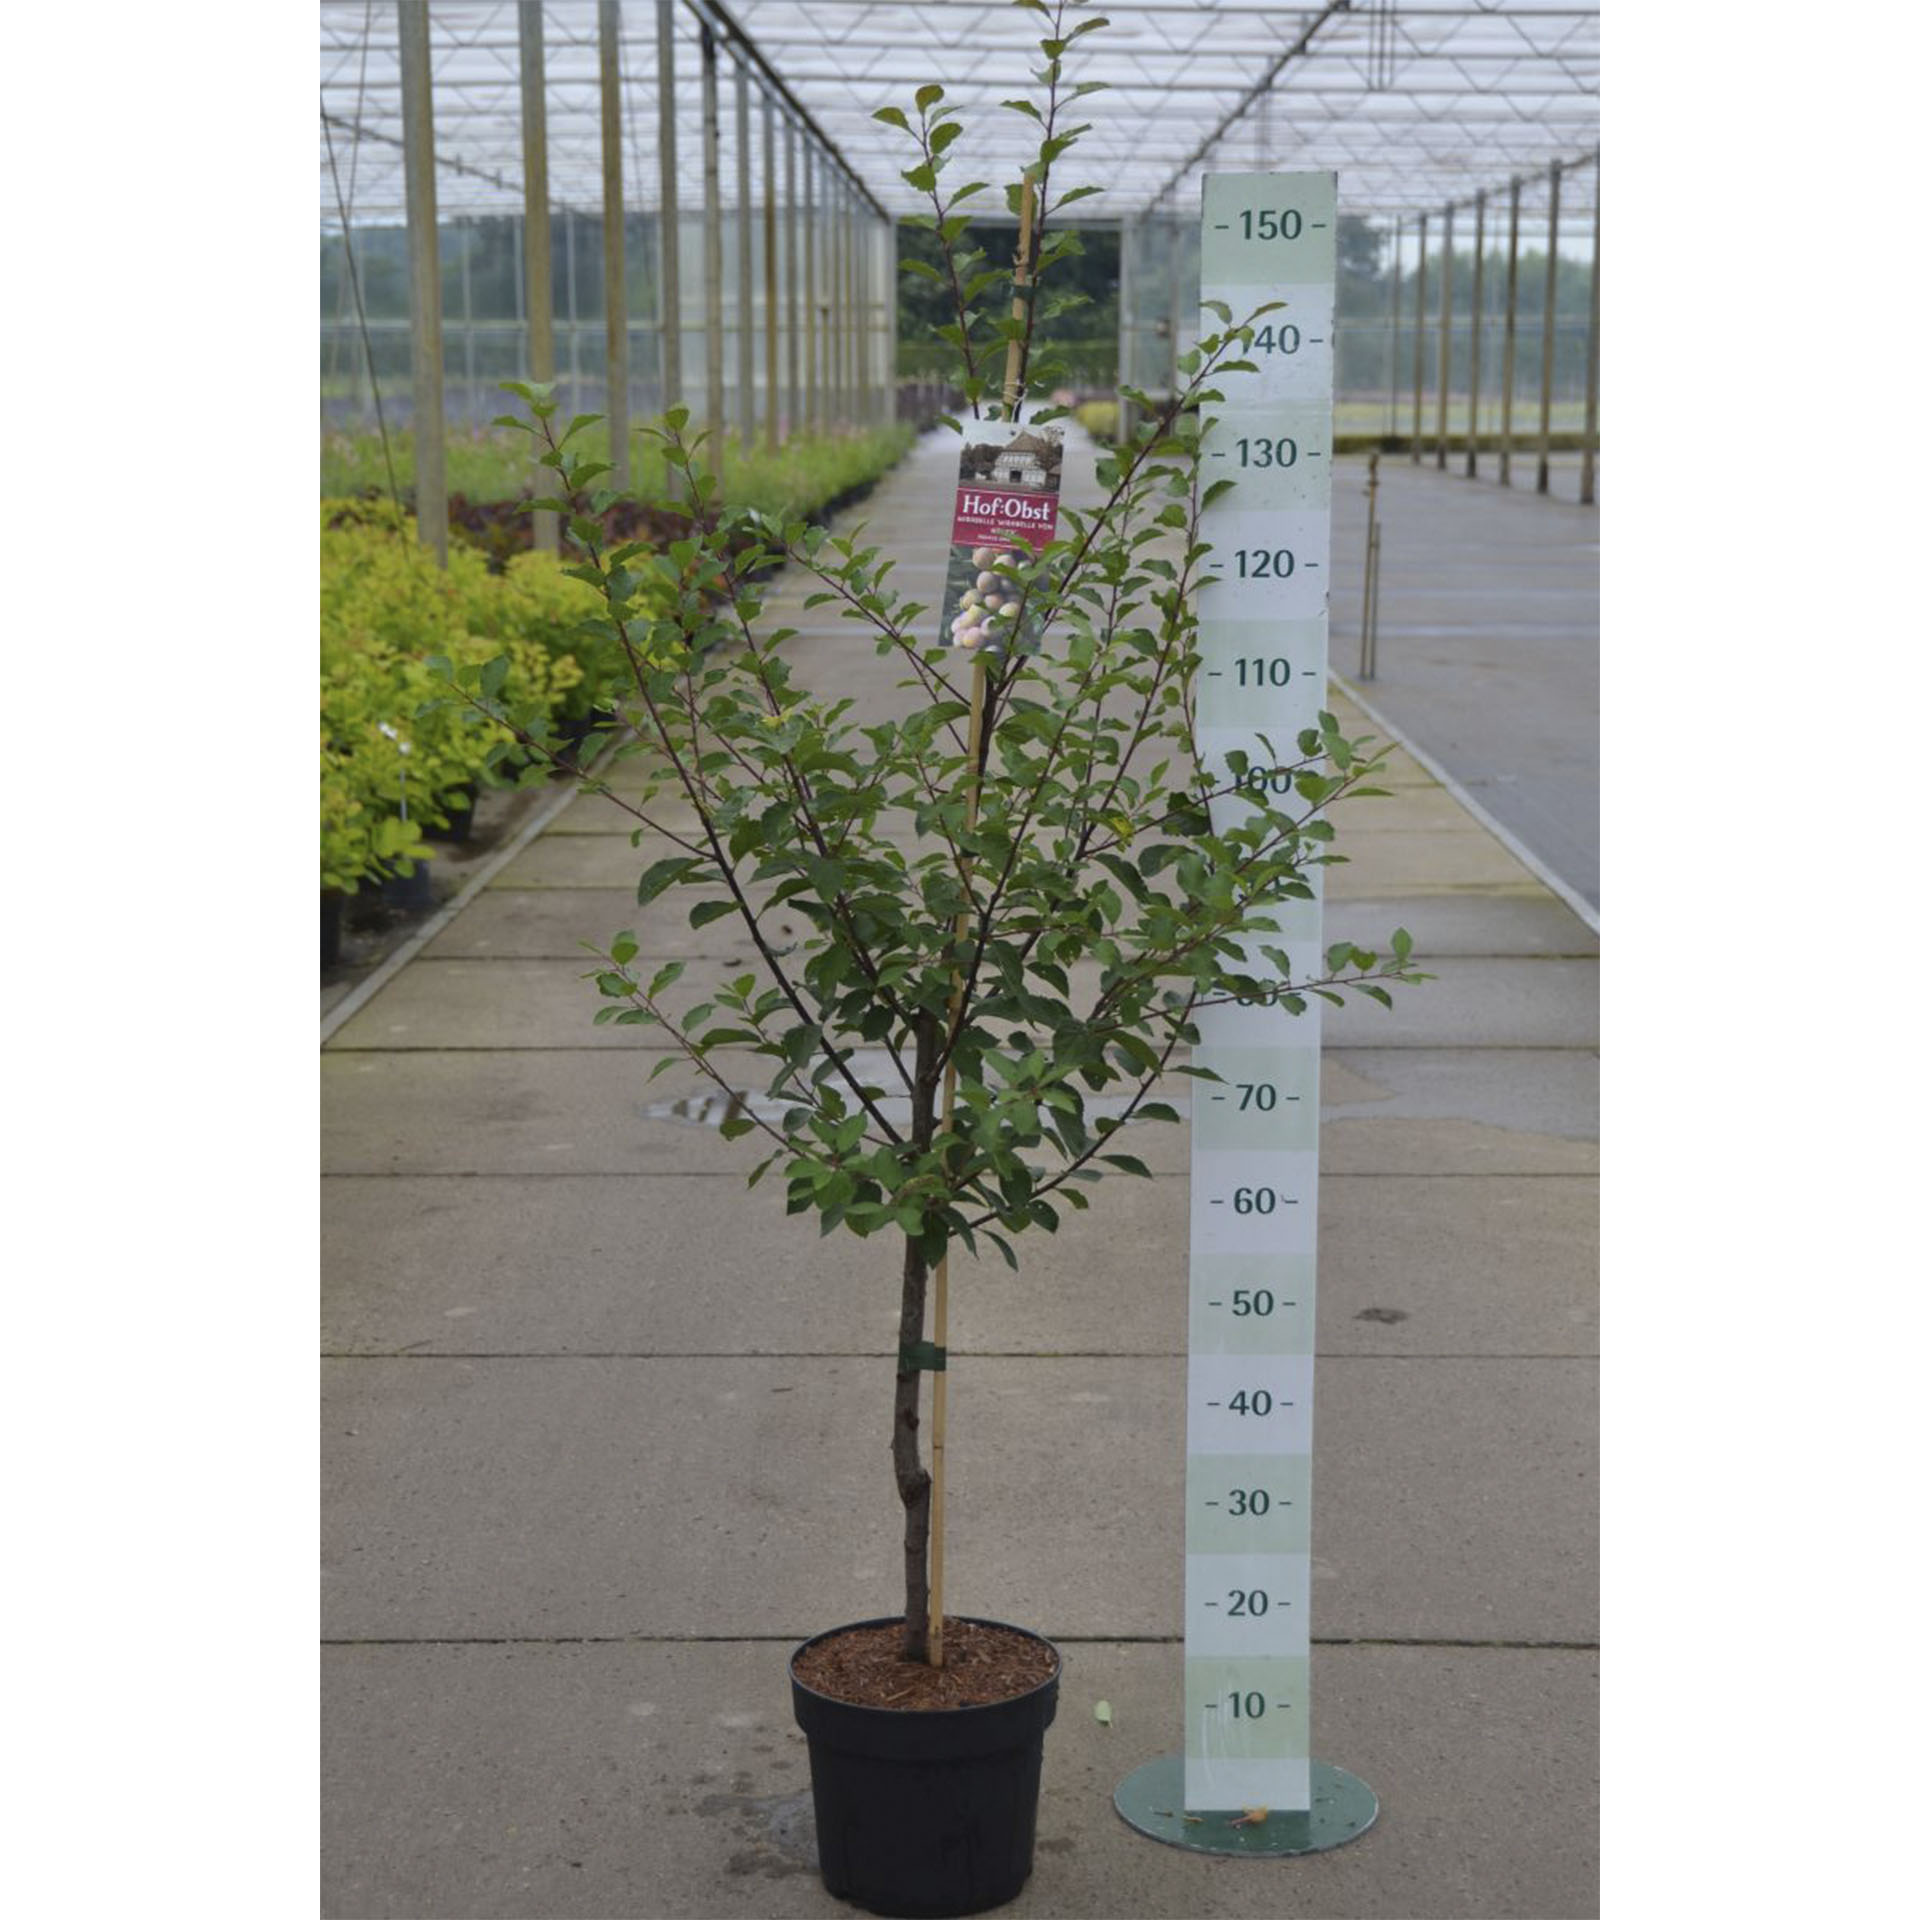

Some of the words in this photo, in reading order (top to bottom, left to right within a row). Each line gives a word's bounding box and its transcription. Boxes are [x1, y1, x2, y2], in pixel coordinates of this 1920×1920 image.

[1239, 209, 1302, 241] 150
[1235, 437, 1298, 468] 130
[1234, 549, 1295, 579] 120
[1234, 658, 1291, 687] 110
[1235, 1083, 1277, 1112] 70
[1233, 1187, 1276, 1215] 60
[1232, 1289, 1274, 1317] 50
[1228, 1390, 1272, 1417] 40
[1228, 1489, 1270, 1517] 30
[1227, 1589, 1269, 1617] 20
[1228, 1692, 1266, 1719] 10
